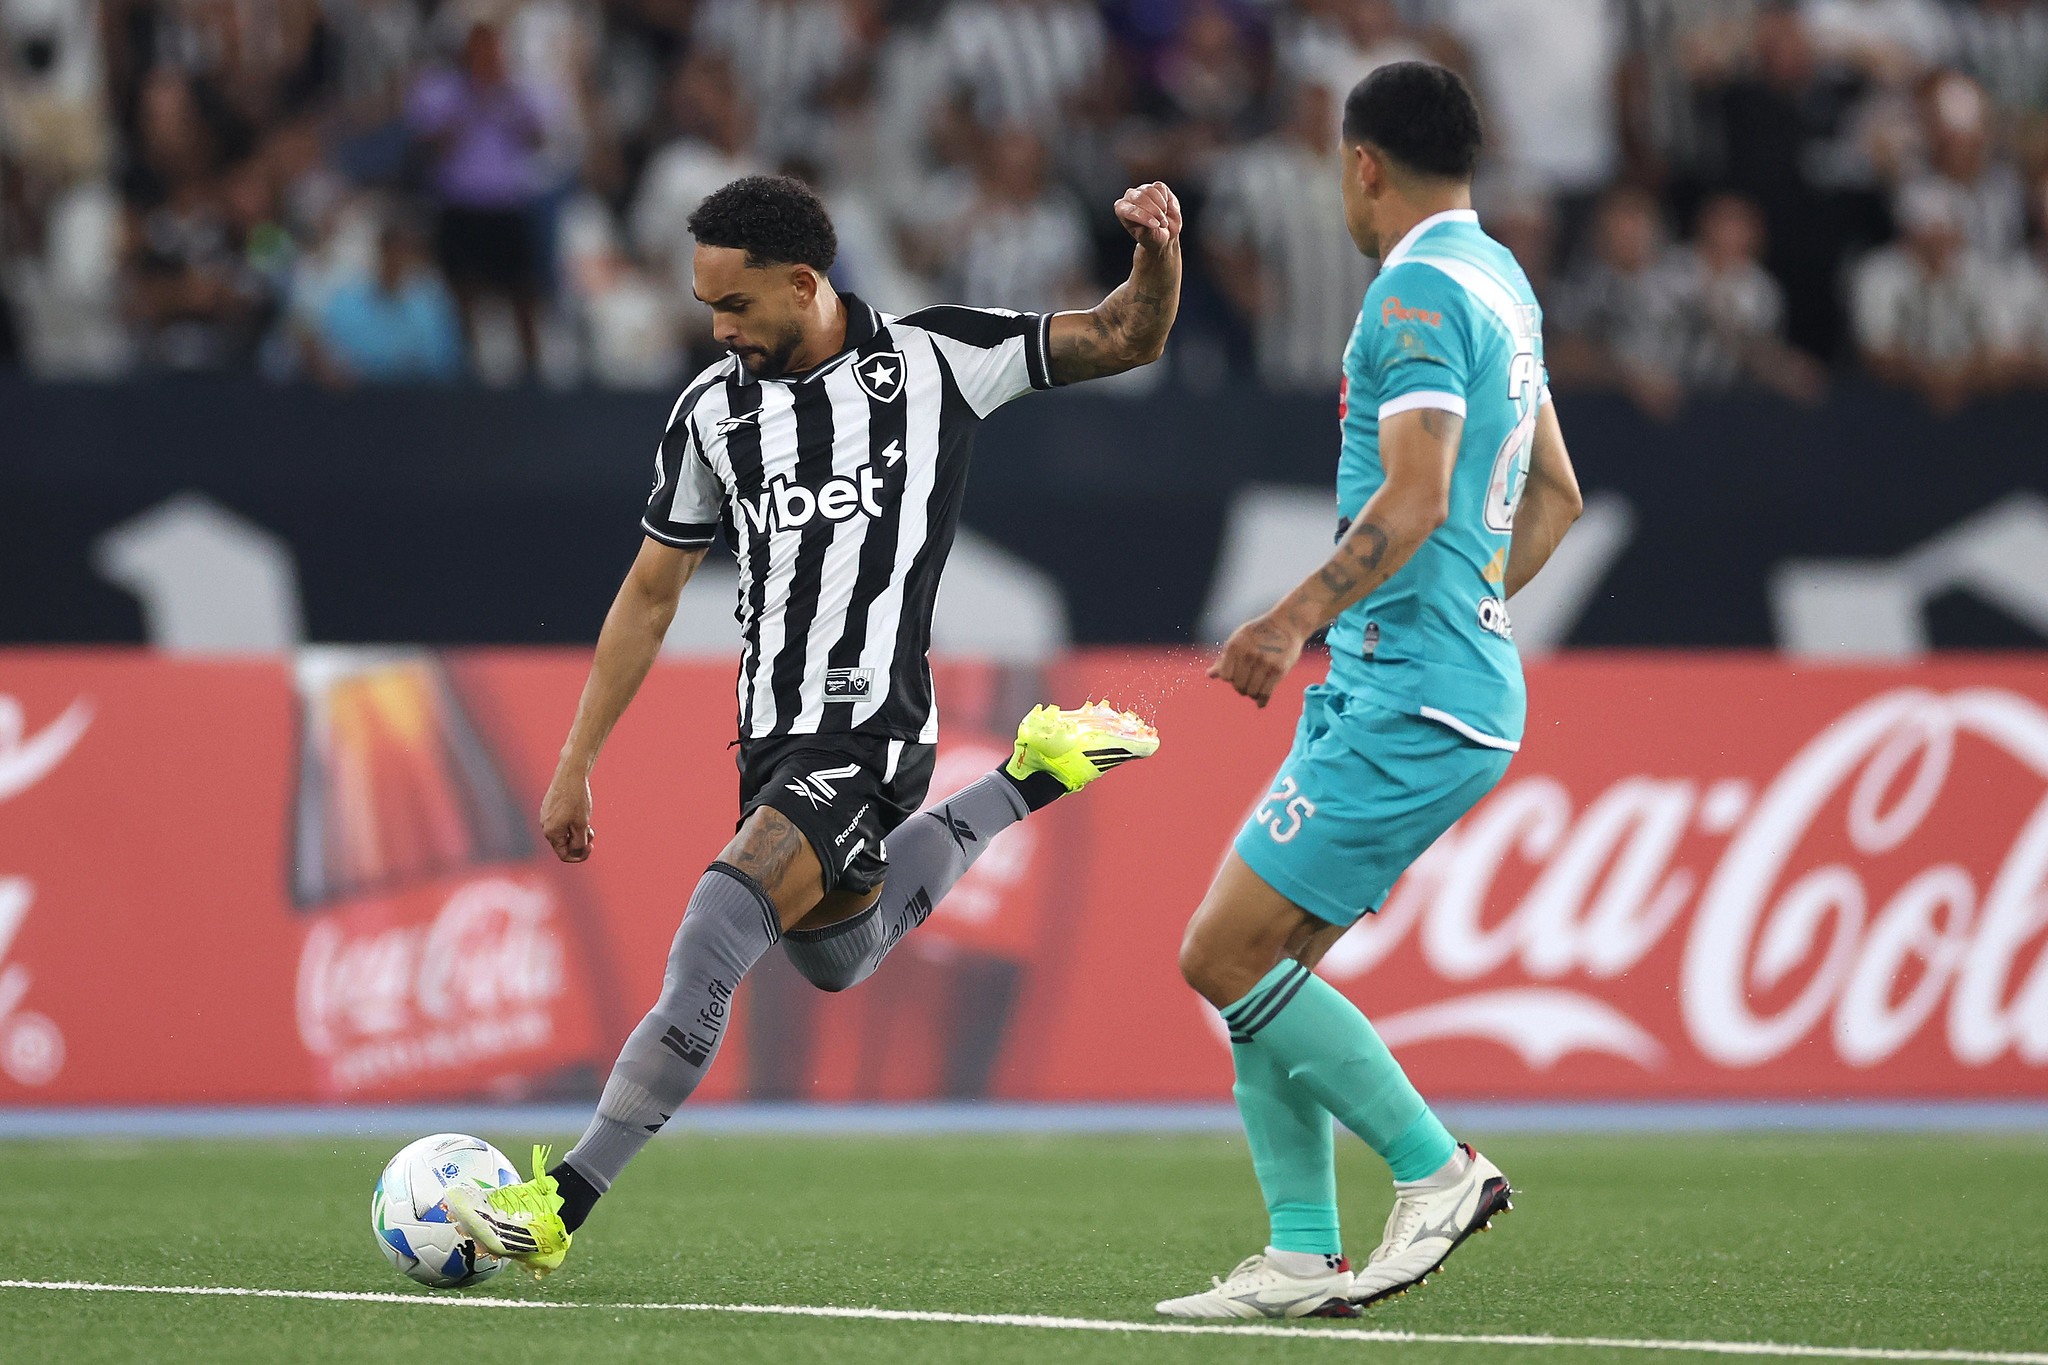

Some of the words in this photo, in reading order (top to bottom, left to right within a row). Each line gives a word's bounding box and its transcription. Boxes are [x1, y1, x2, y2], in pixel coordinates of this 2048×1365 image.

[739, 466, 884, 534] vbet
[834, 803, 870, 847] Reebok
[1256, 776, 1315, 843] 25
[689, 978, 732, 1048] Lifefit
